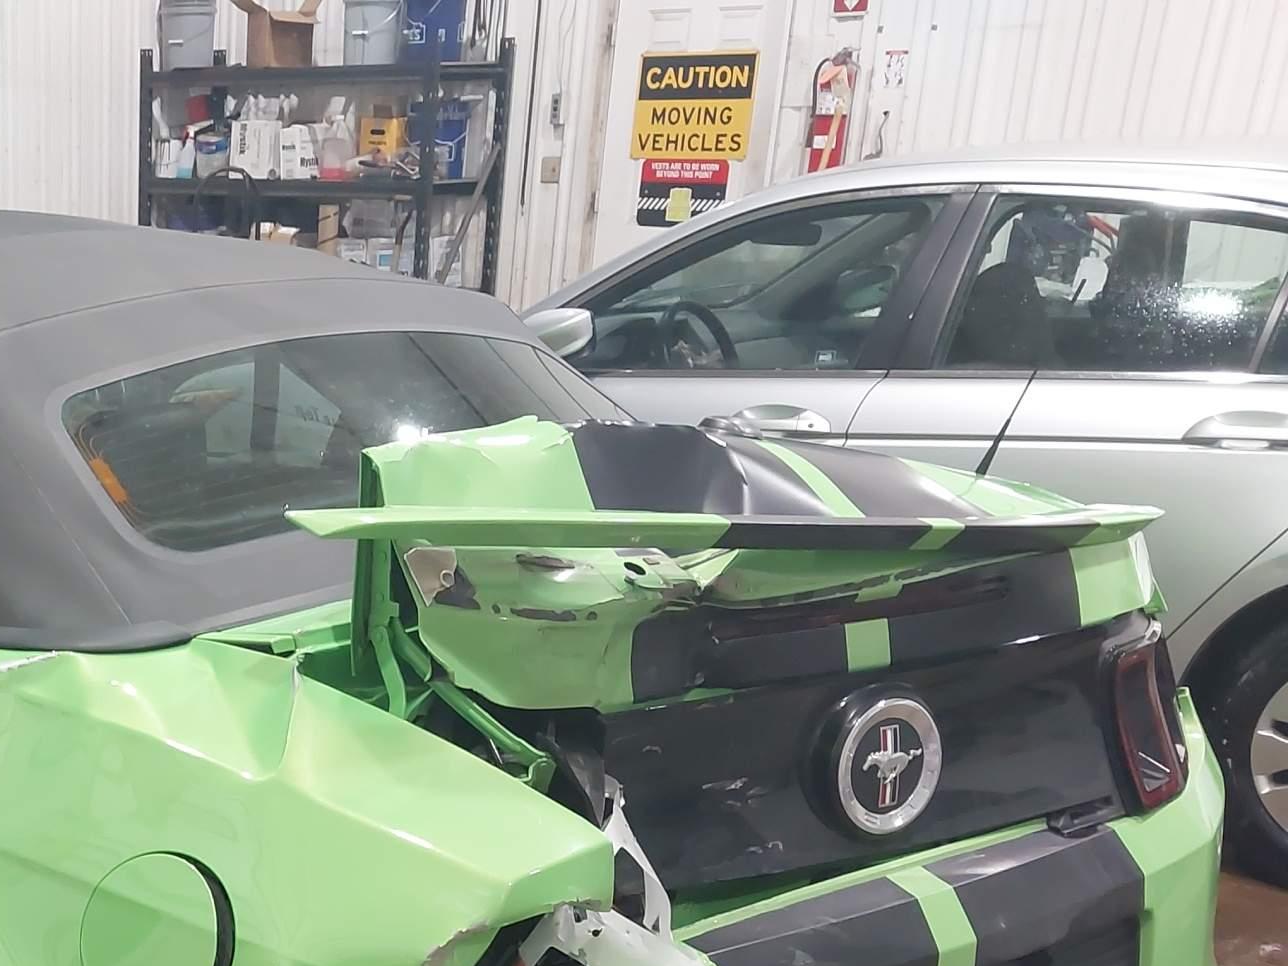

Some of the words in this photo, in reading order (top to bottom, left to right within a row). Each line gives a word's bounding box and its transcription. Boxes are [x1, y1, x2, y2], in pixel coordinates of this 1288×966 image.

[646, 65, 749, 89] CAUTION
[651, 106, 732, 125] MOVING
[638, 133, 742, 152] VEHICLES
[670, 162, 682, 170] ARE
[700, 163, 720, 171] WORN
